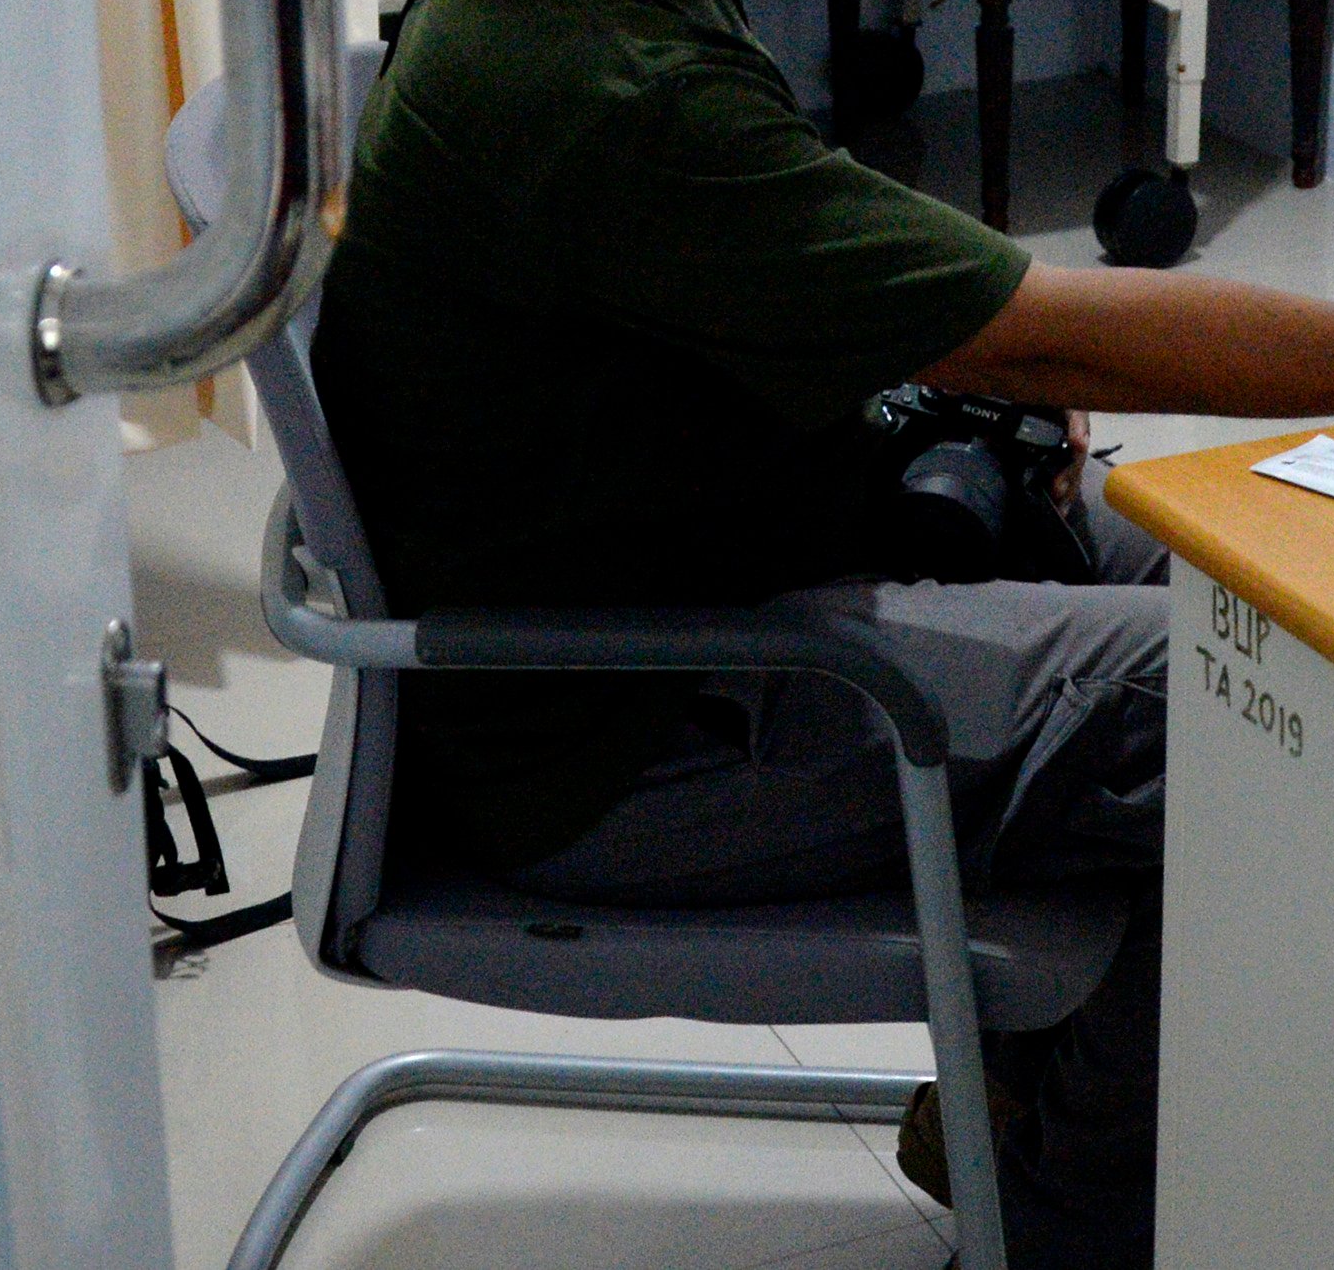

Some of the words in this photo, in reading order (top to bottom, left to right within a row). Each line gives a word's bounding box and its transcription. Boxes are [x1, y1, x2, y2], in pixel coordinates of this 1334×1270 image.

[961, 403, 1001, 422] SONY
[1211, 583, 1272, 665] BUP
[1195, 644, 1232, 708] TA
[1241, 678, 1304, 758] 2019
